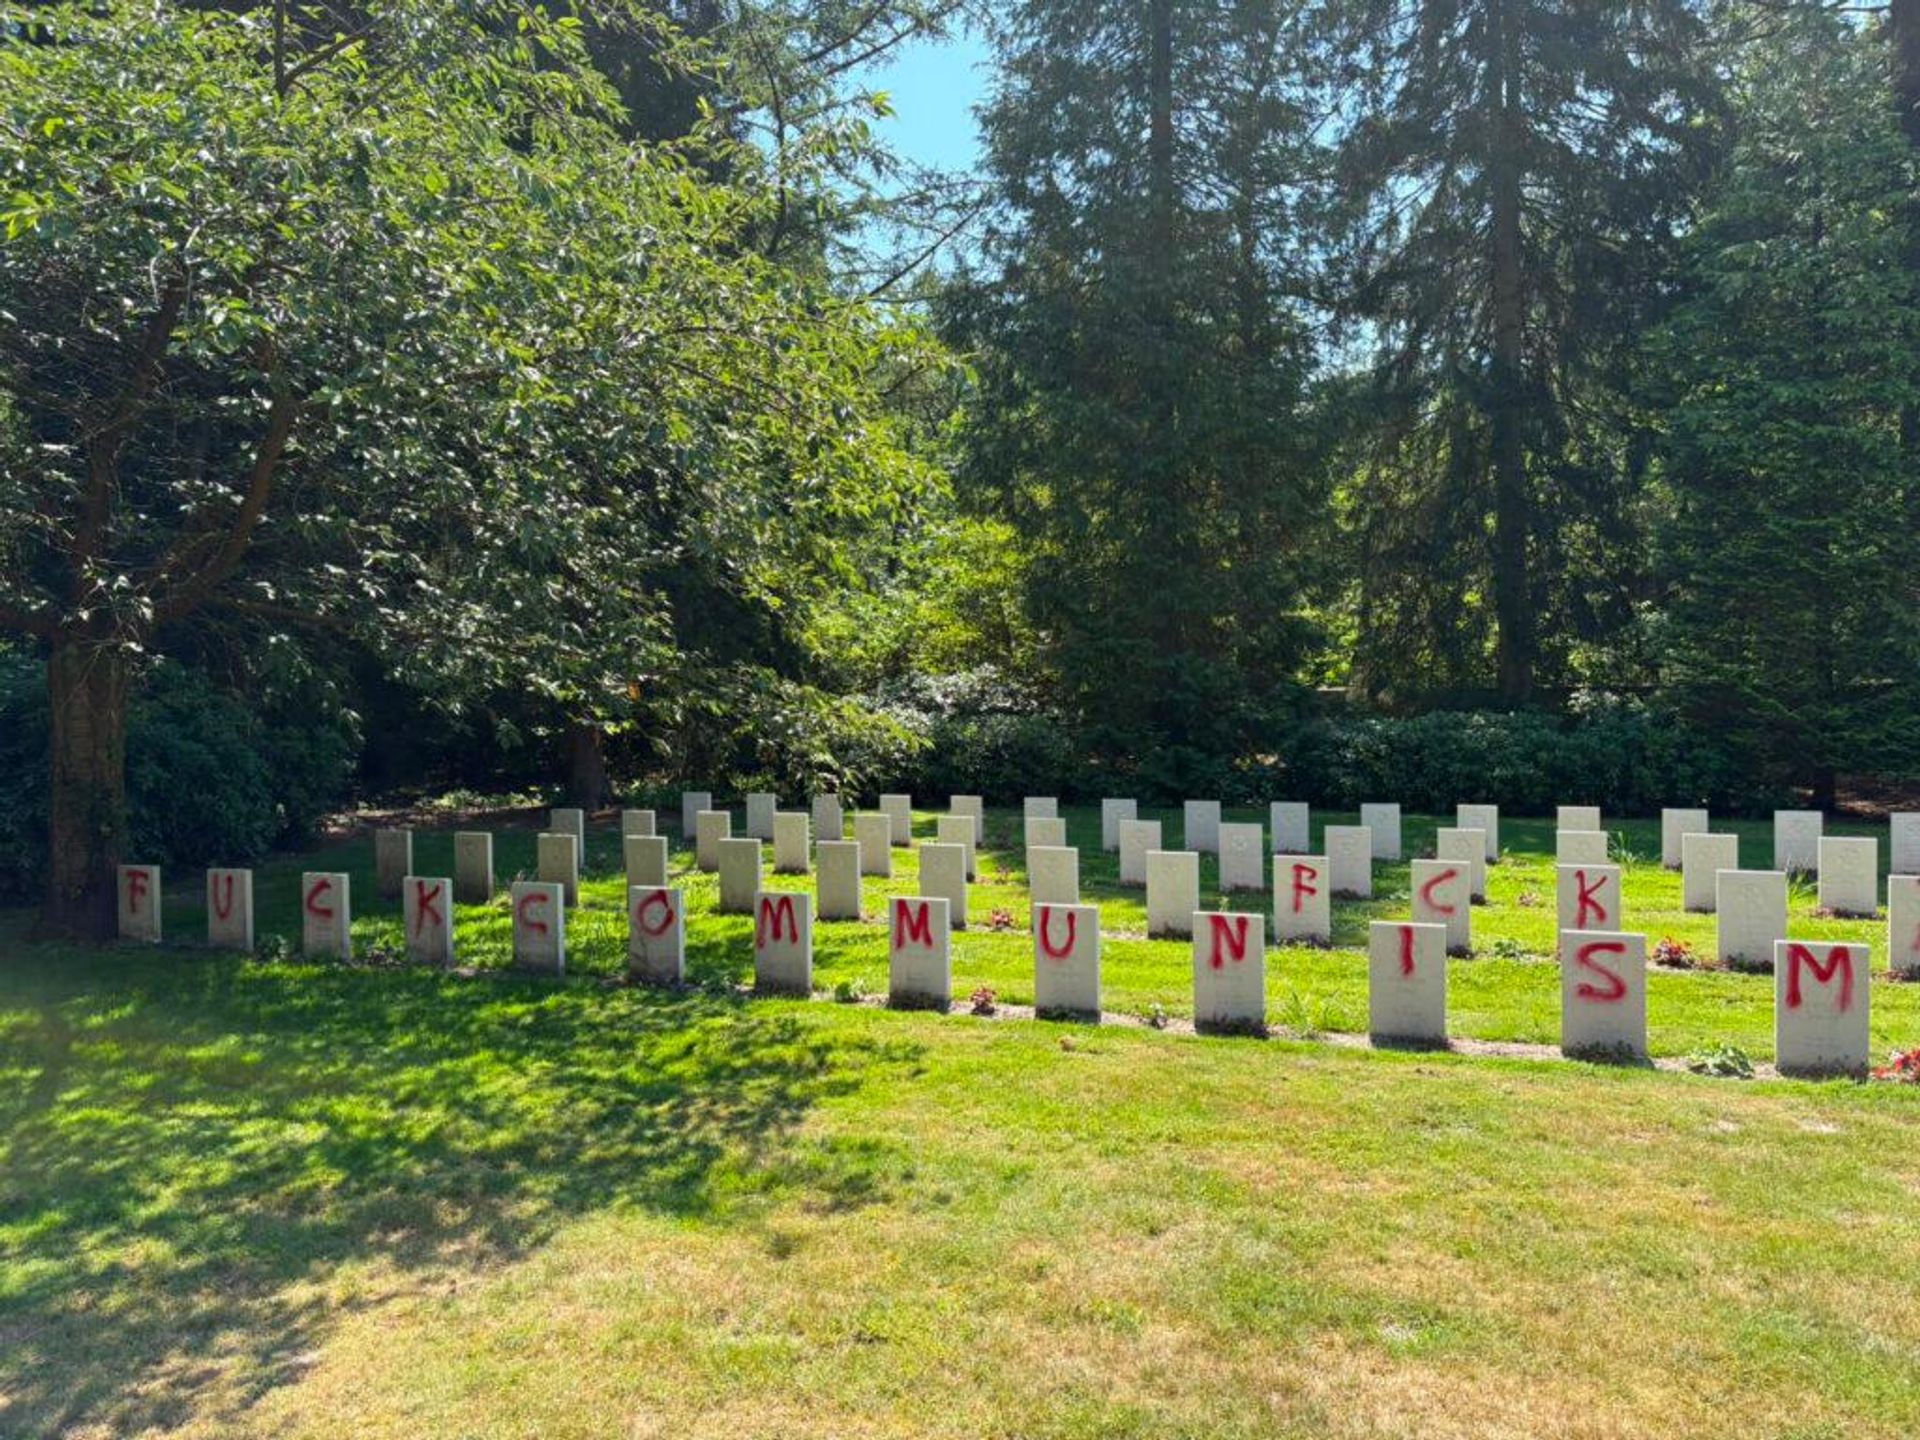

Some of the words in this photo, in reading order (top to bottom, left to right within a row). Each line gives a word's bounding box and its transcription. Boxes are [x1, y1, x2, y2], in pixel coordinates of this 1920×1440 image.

[126, 870, 150, 914] F
[212, 874, 233, 920] U
[306, 879, 333, 918] C
[416, 879, 442, 936] K
[518, 893, 548, 933] C
[638, 890, 675, 935] O
[757, 896, 799, 948] M
[894, 898, 934, 949] M
[1039, 906, 1077, 960] U
[1208, 914, 1249, 970] N
[1398, 925, 1415, 977] I
[1575, 942, 1628, 1003] S
[1785, 944, 1855, 1012] M
[1419, 869, 1458, 916] C
[1575, 869, 1608, 928] K
